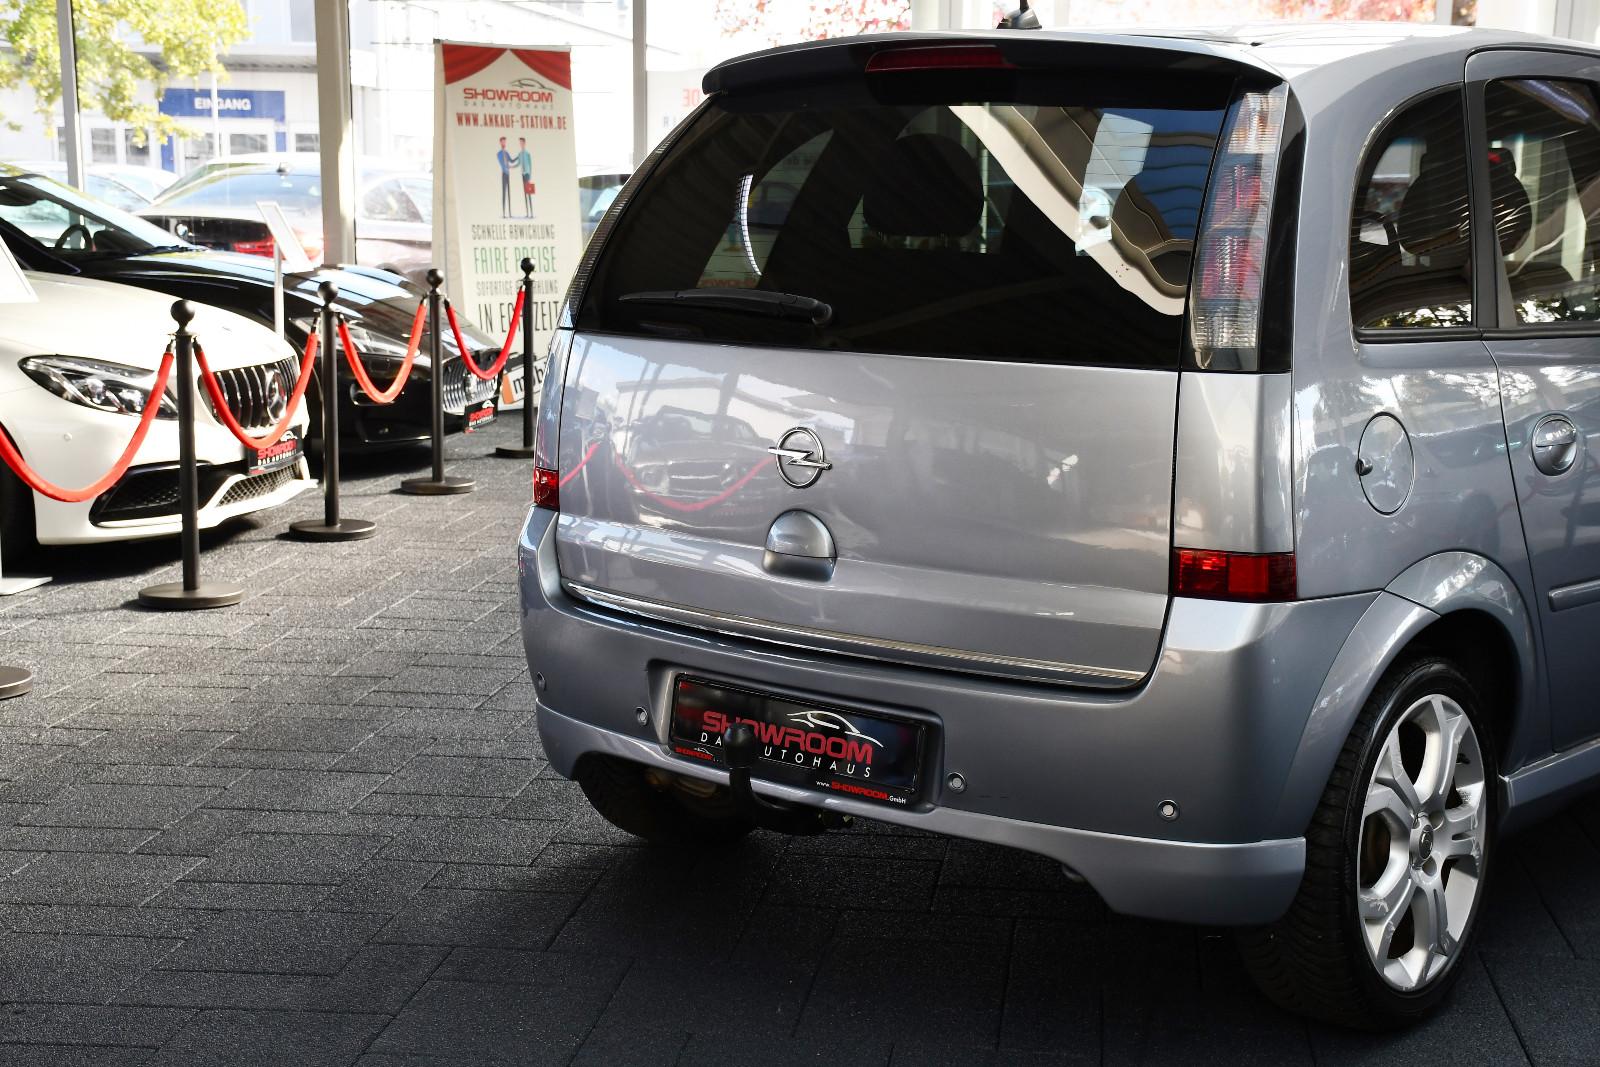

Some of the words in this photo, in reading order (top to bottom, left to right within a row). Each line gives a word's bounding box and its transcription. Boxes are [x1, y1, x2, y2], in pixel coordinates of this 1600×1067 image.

[194, 96, 252, 111] EINGANG
[463, 87, 553, 103] SHOWROOM
[455, 111, 567, 131] WWW.ANKAUF-STATION.DE
[471, 223, 507, 241] SCHNELLE
[508, 223, 556, 241] ABWICKLUNG
[473, 246, 510, 275] FAIRE
[478, 303, 494, 334] IN
[499, 300, 560, 333] ECZEIT
[763, 745, 871, 779] UTOHAUS
